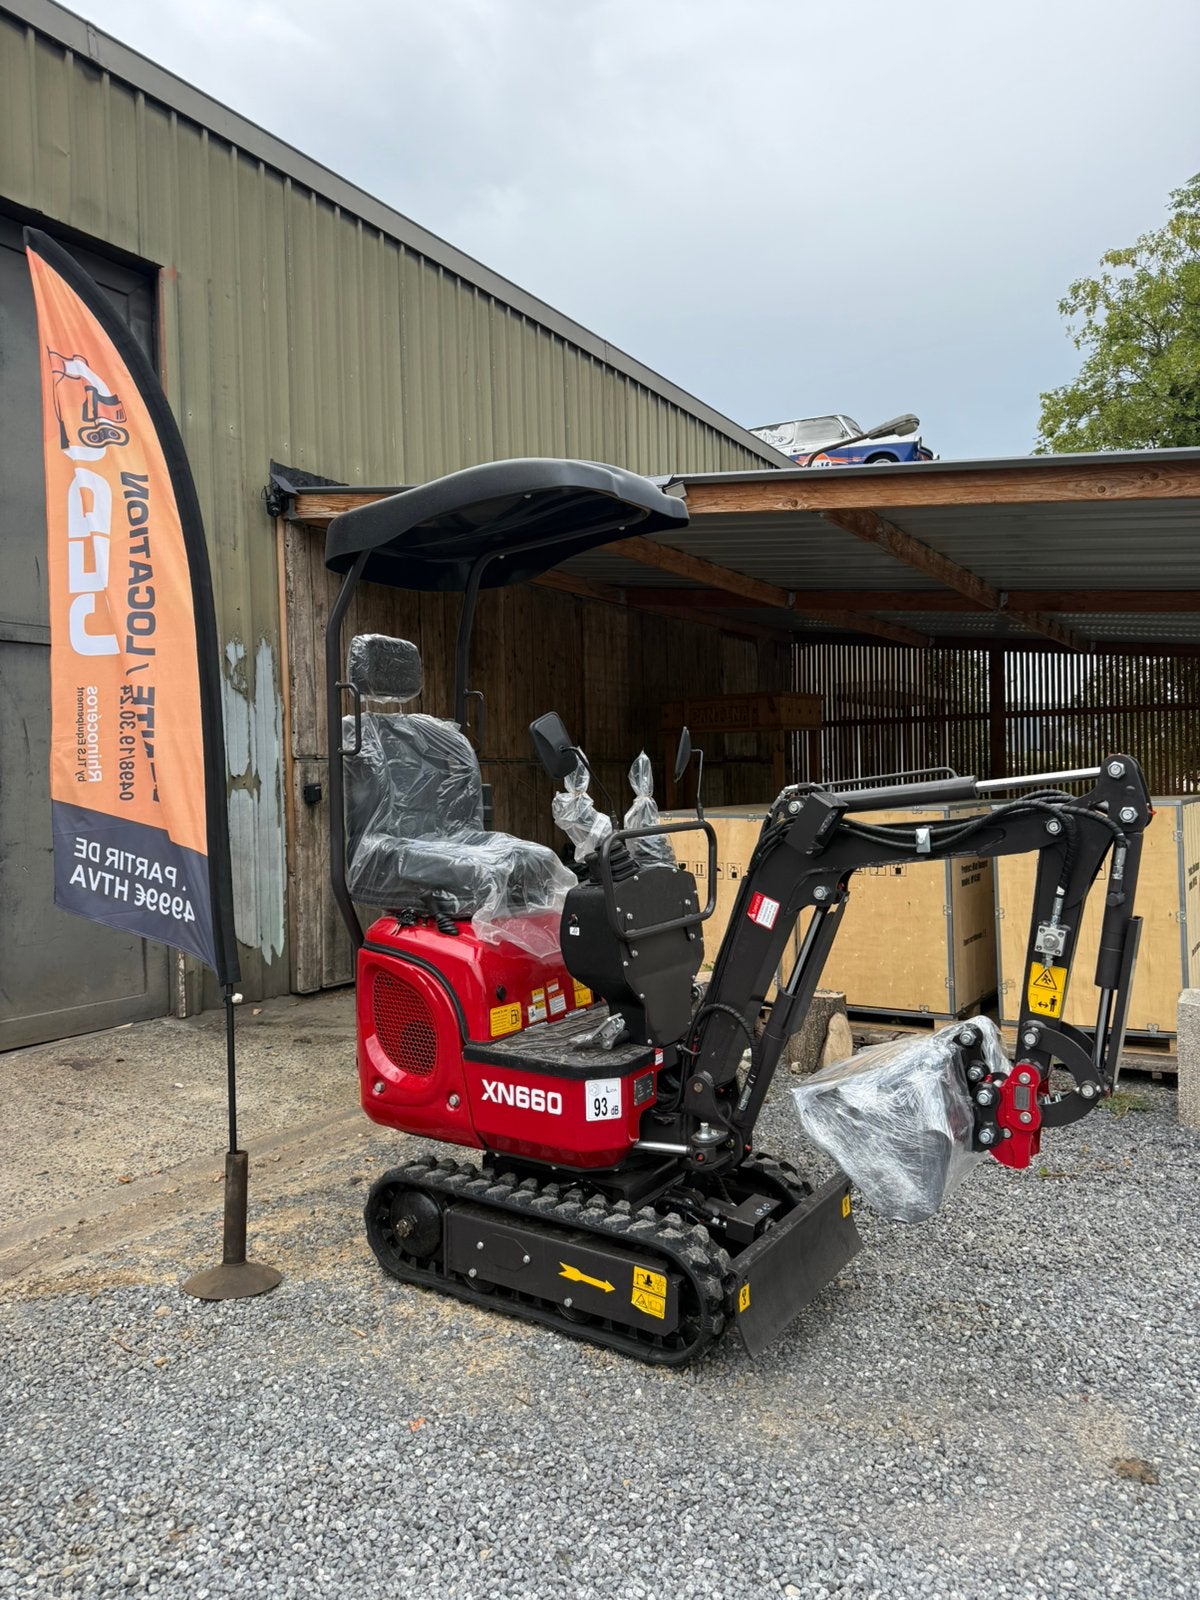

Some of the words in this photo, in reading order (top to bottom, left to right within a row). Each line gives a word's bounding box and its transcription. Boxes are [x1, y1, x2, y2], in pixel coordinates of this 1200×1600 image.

[481, 1079, 562, 1115] XN660
[594, 1097, 608, 1117] 93
[611, 1105, 620, 1115] dB
